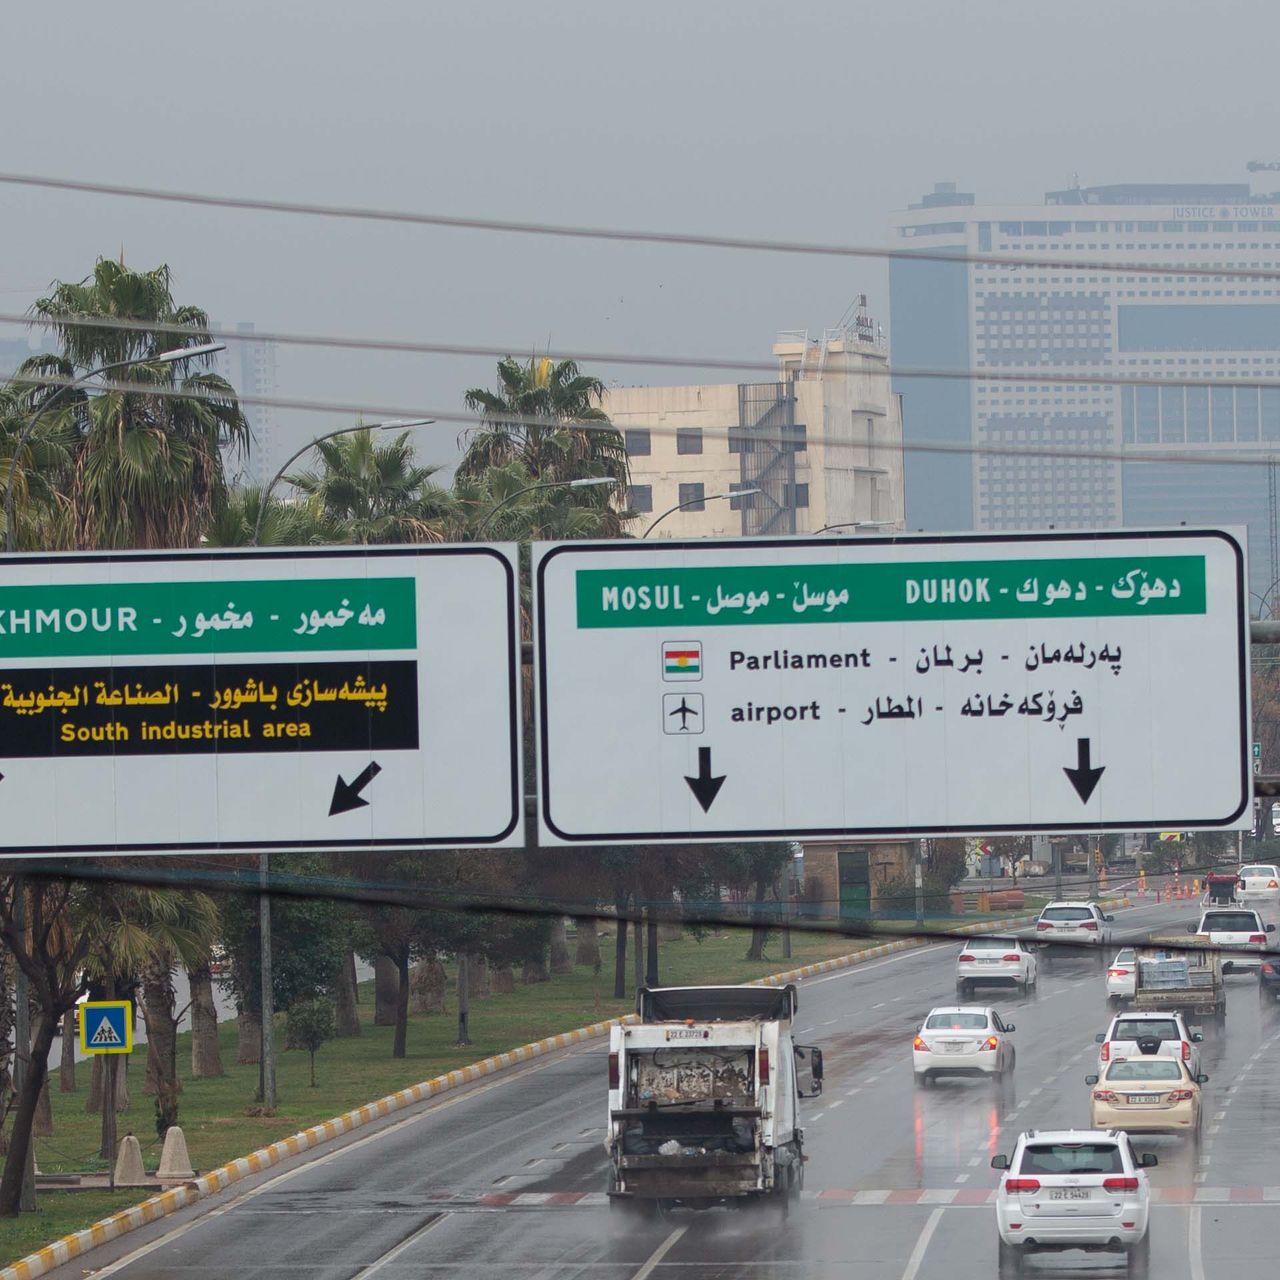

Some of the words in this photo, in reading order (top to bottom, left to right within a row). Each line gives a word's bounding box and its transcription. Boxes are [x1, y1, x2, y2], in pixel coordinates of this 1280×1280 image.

[1173, 207, 1216, 220] JUSTICE
[1233, 207, 1275, 218] TOWER
[602, 585, 684, 611] MOSUL
[706, 584, 770, 615] موصل
[906, 578, 991, 604] DUHOK
[1016, 578, 1087, 606] دهوك
[171, 601, 254, 637] مخمور
[729, 647, 871, 671] Parliament
[914, 643, 985, 674] برلمان
[0, 683, 89, 715] الجنوبية
[93, 681, 179, 706] الصناعة
[208, 677, 278, 710] باشوور
[731, 698, 821, 725] airport
[860, 694, 923, 725] المطار
[60, 722, 129, 742] South
[141, 719, 251, 740] industrial
[263, 722, 311, 738] area
